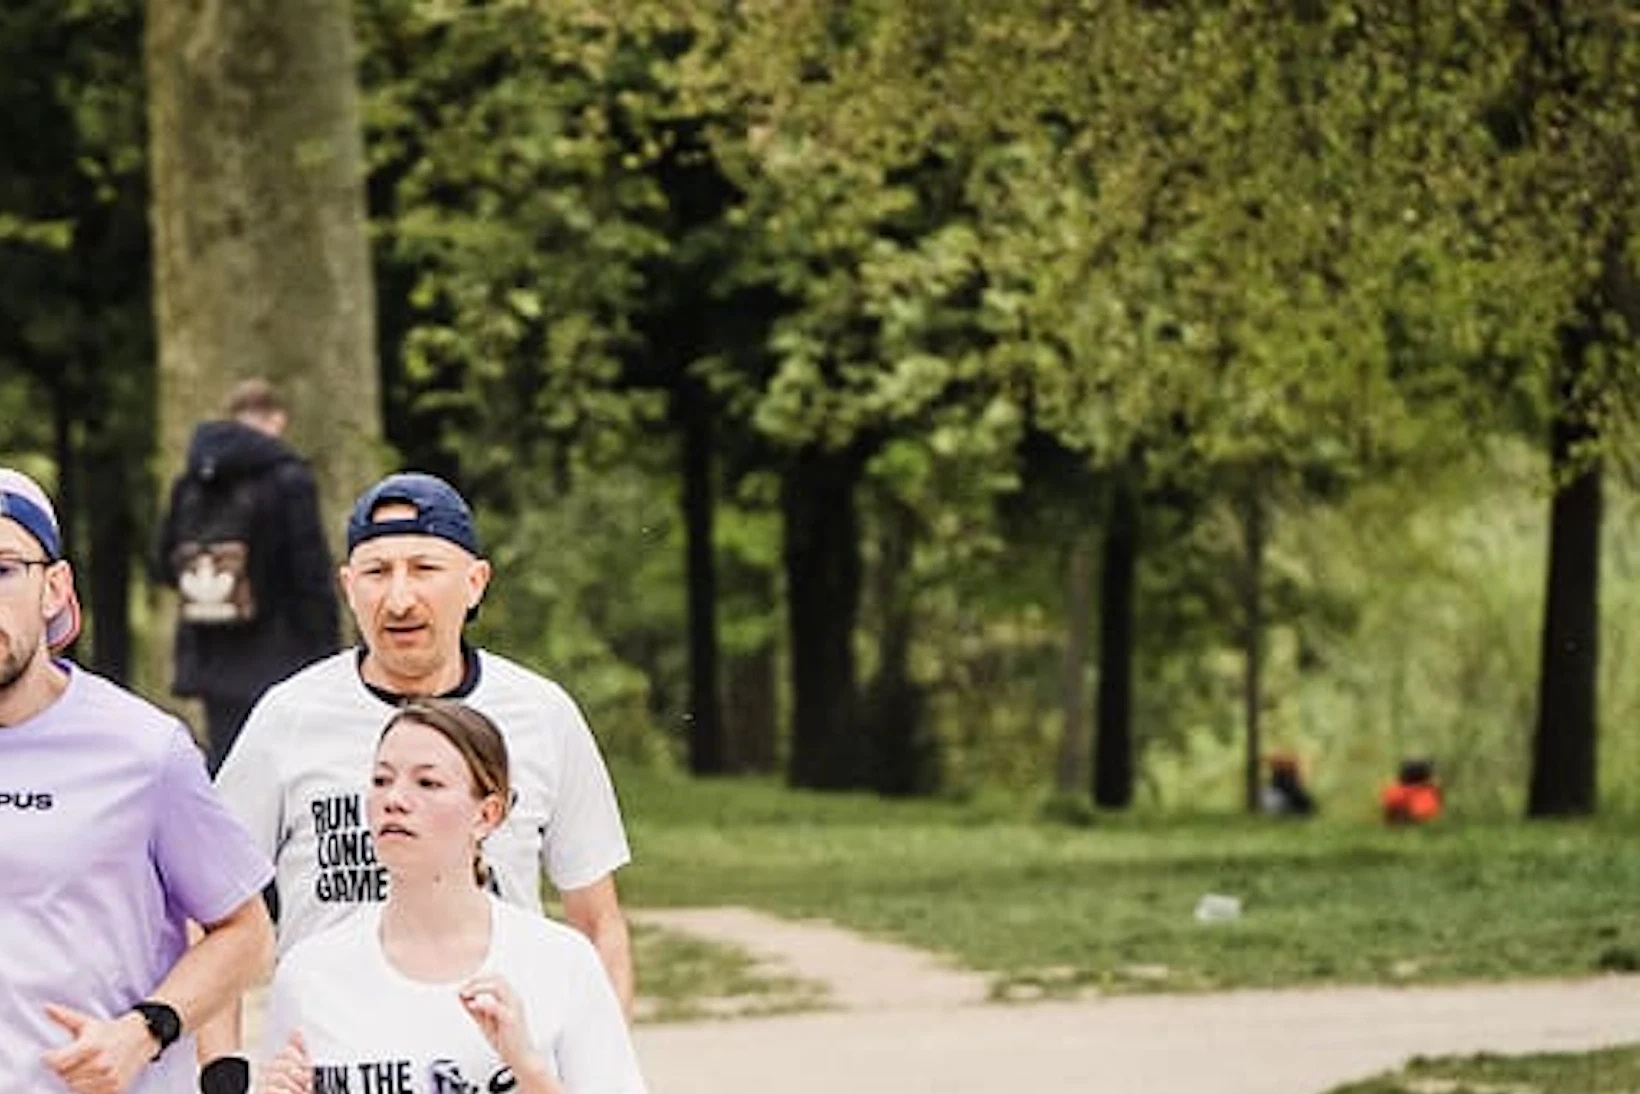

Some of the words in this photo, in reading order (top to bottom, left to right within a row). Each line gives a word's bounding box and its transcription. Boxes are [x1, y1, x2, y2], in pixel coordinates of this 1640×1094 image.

[312, 794, 360, 834] RUN
[318, 831, 376, 868] LONG
[316, 867, 387, 902] GAME
